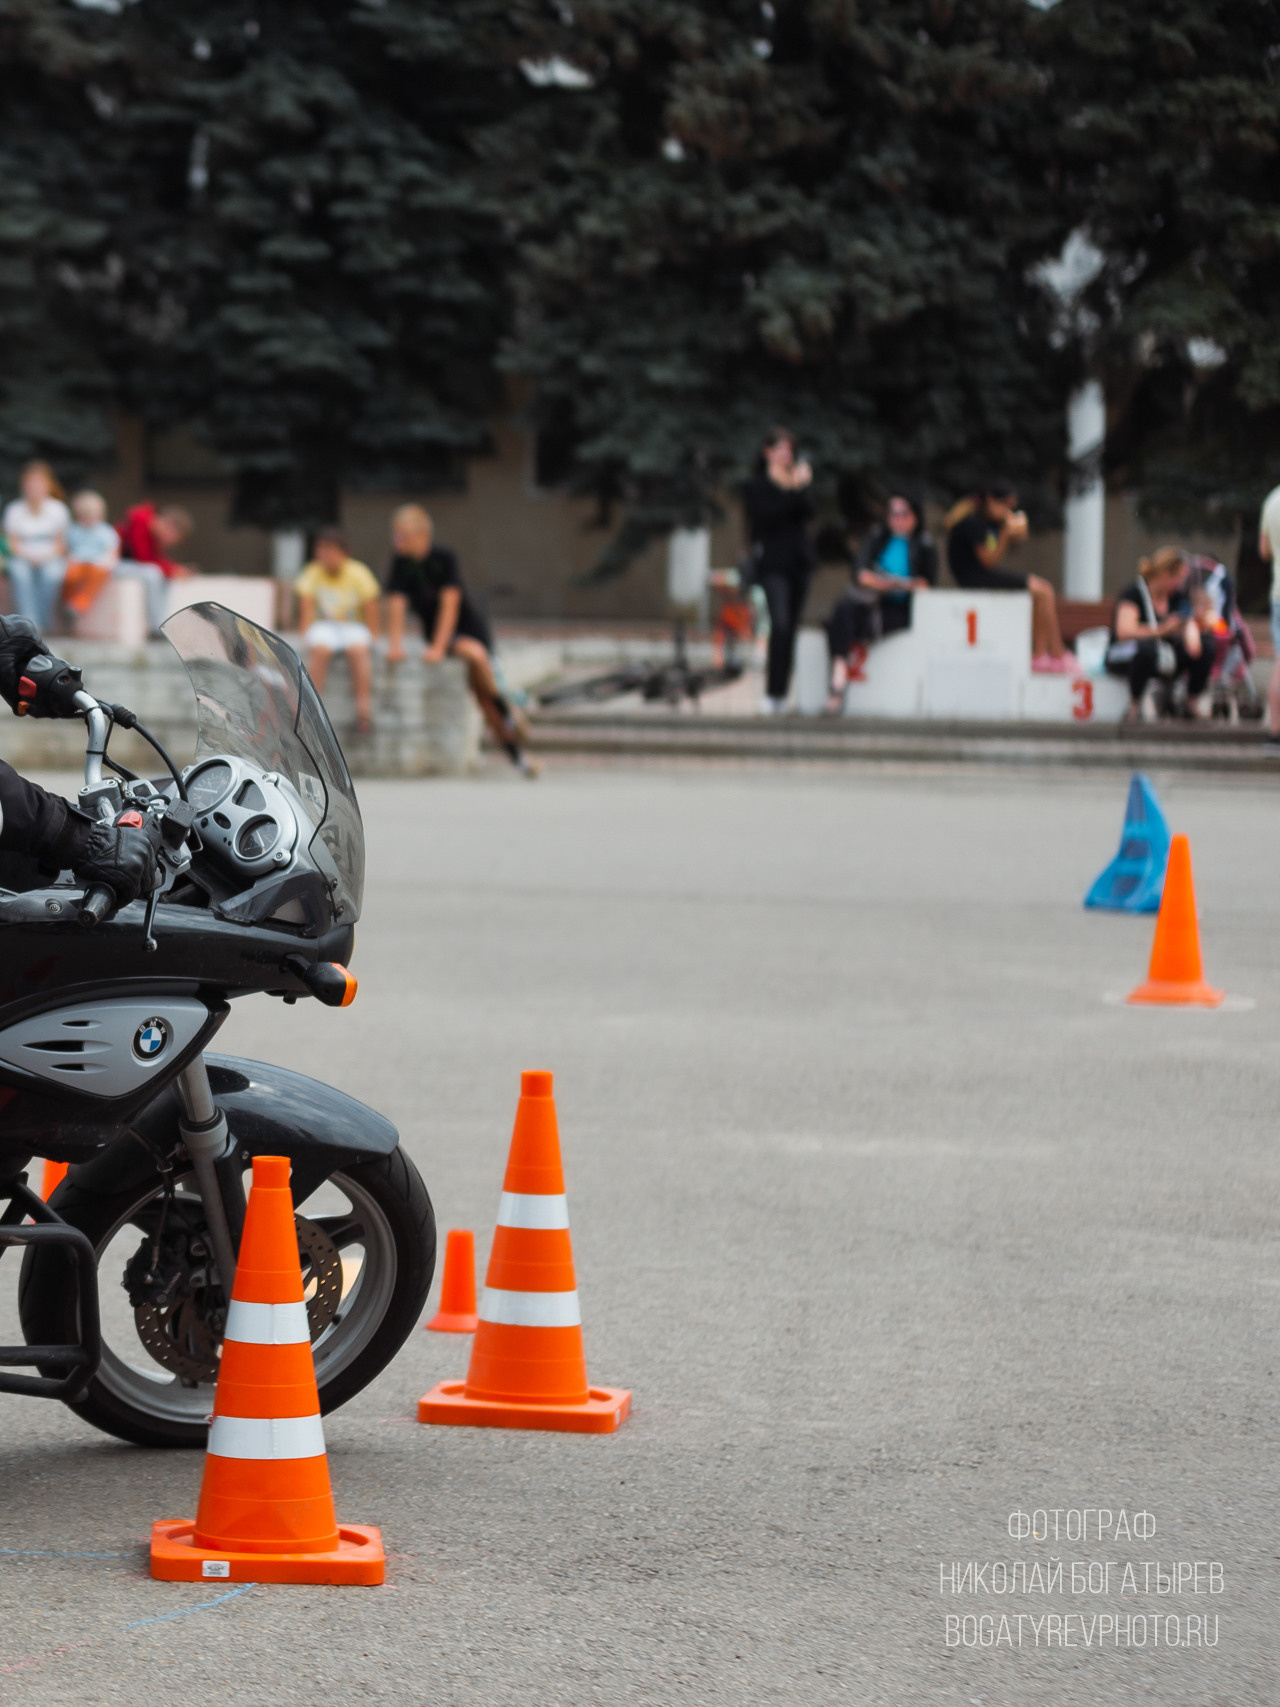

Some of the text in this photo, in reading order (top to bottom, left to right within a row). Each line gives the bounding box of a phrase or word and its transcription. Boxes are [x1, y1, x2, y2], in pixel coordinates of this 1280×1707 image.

[966, 610, 977, 646] 1
[1072, 680, 1094, 720] 3
[139, 1020, 166, 1034] BMW
